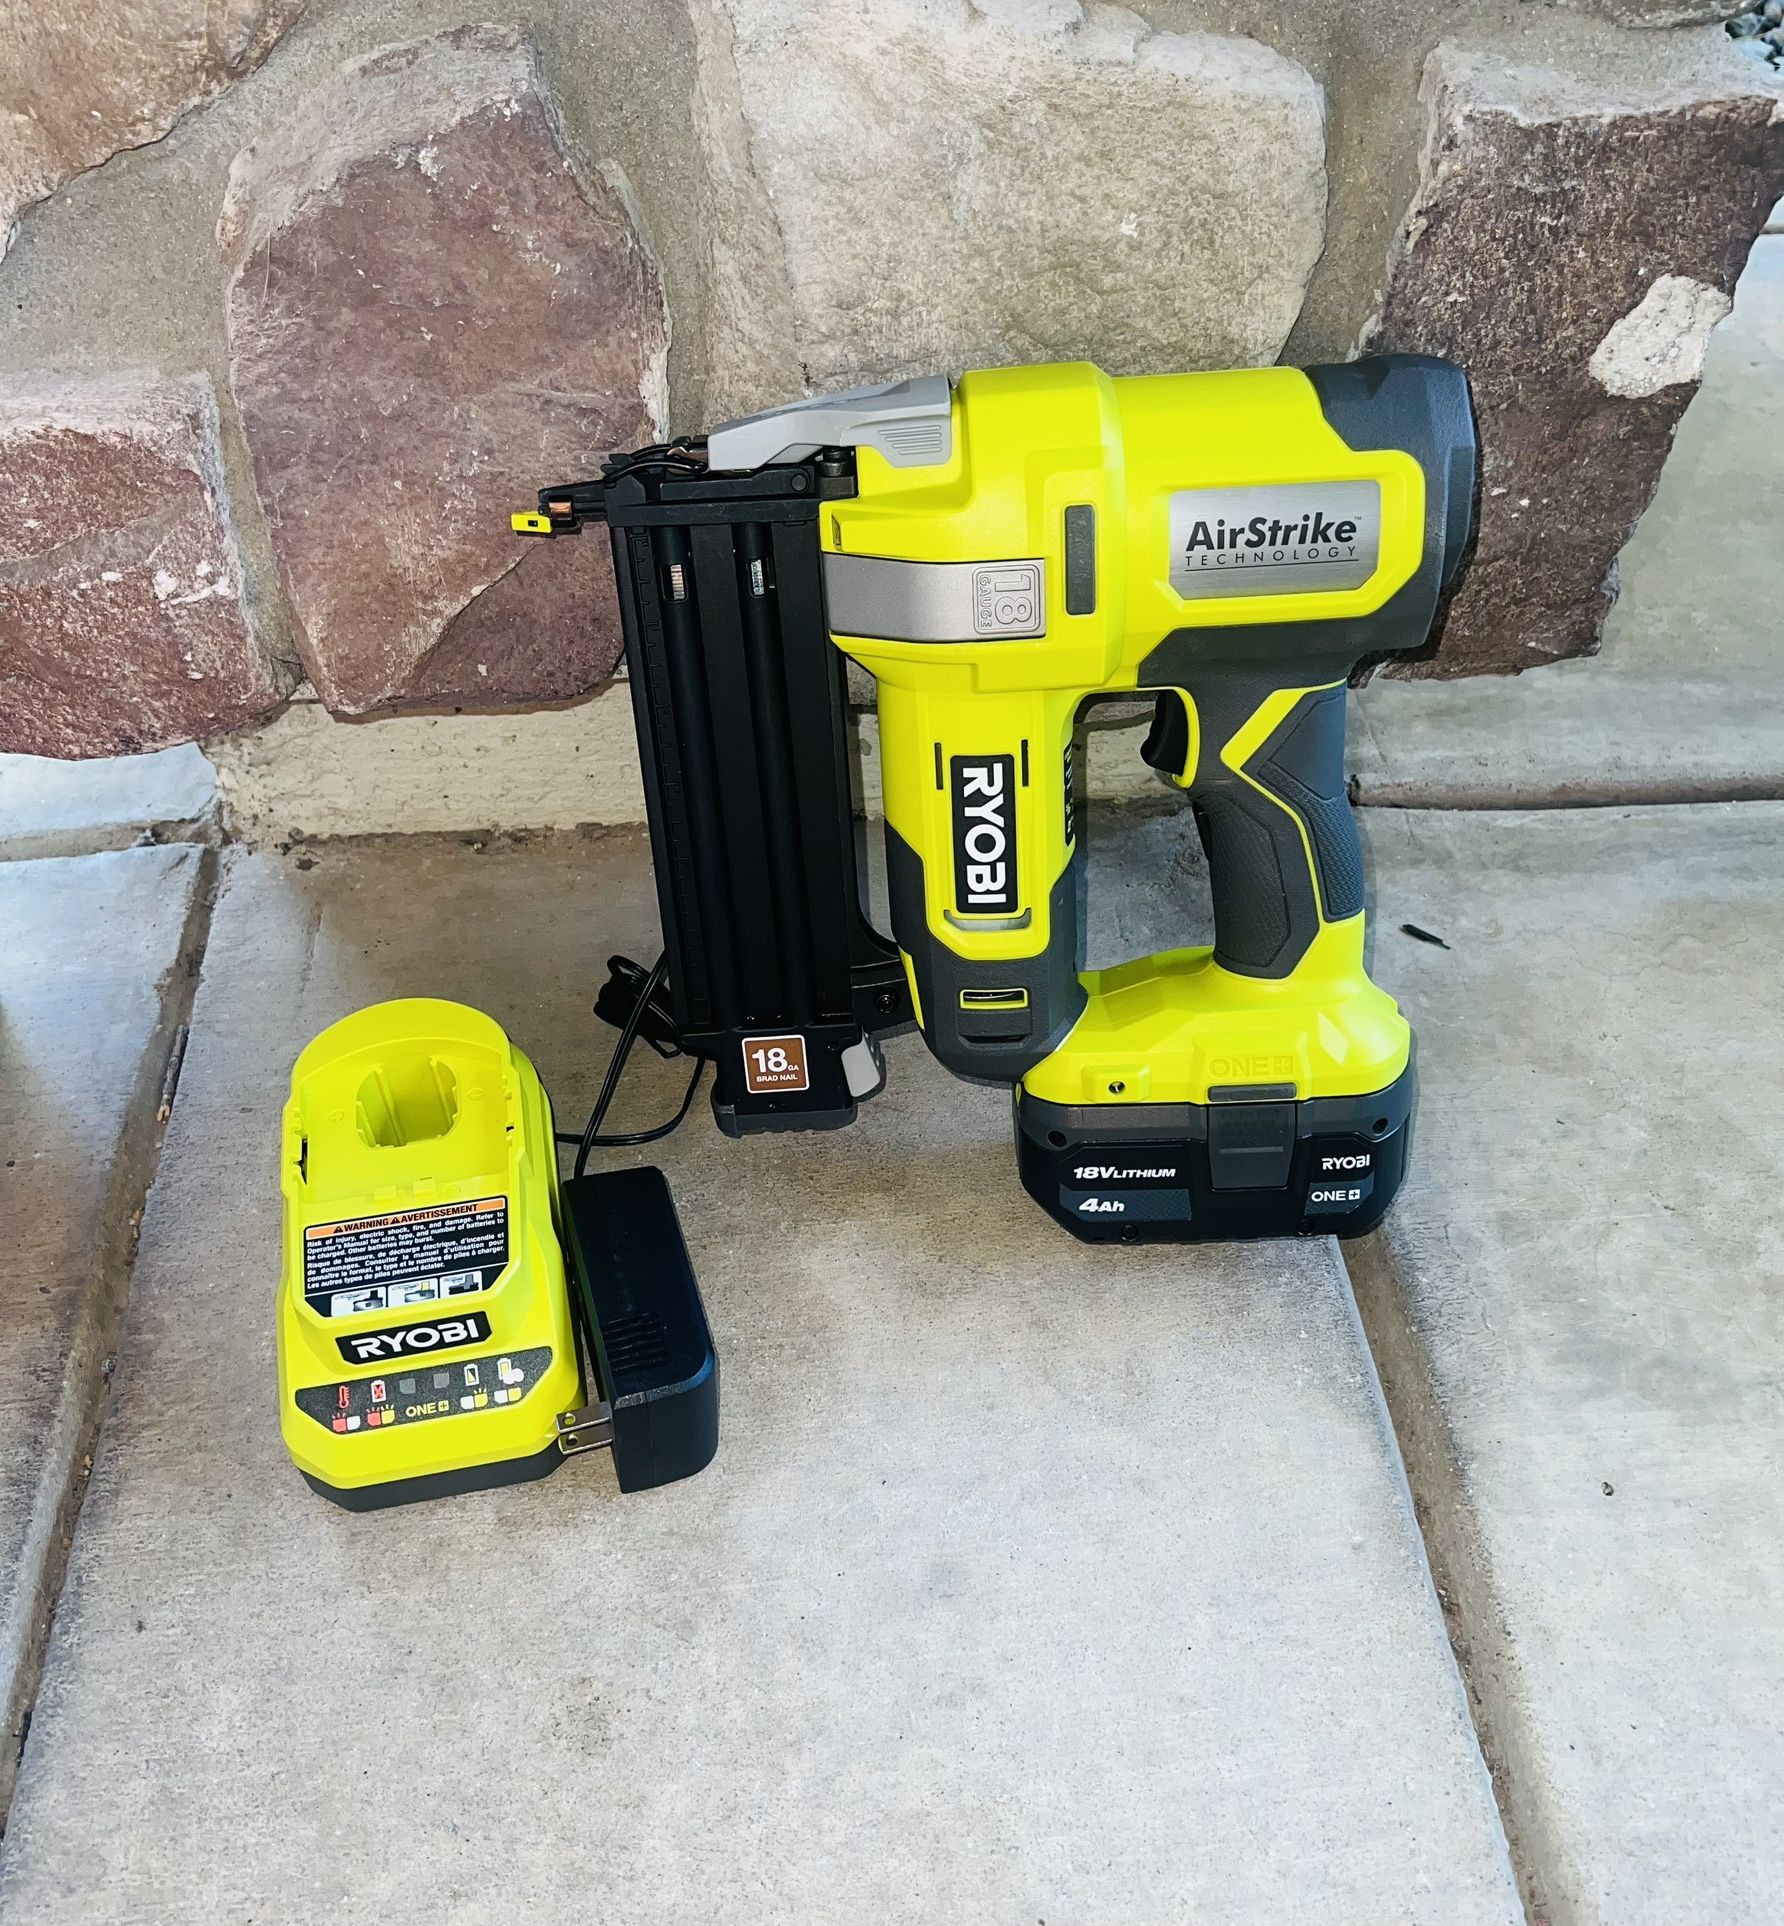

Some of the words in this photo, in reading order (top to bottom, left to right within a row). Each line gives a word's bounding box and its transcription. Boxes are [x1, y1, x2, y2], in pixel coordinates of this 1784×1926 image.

[1184, 546, 1356, 567] TECHNOLOGY
[979, 574, 992, 628] GAUGE
[995, 574, 1032, 625] 18
[962, 762, 1006, 904] RYOBI
[1322, 1154, 1370, 1170] RYOBI
[1079, 1198, 1125, 1212] 4Ah
[344, 1218, 389, 1231] WARNING
[400, 1204, 478, 1222] AVERTISSEMENT
[344, 1240, 368, 1248] Manual
[431, 1226, 456, 1234] number
[466, 1220, 495, 1228] batteries
[360, 1230, 384, 1239] electric
[368, 1242, 397, 1251] batteries
[307, 1260, 330, 1269] Risque
[365, 1256, 398, 1266] Consulter
[414, 1250, 439, 1258] manuel
[416, 1256, 442, 1264] nombre
[392, 1266, 419, 1275] peuvent
[351, 1318, 479, 1359] RYOBI
